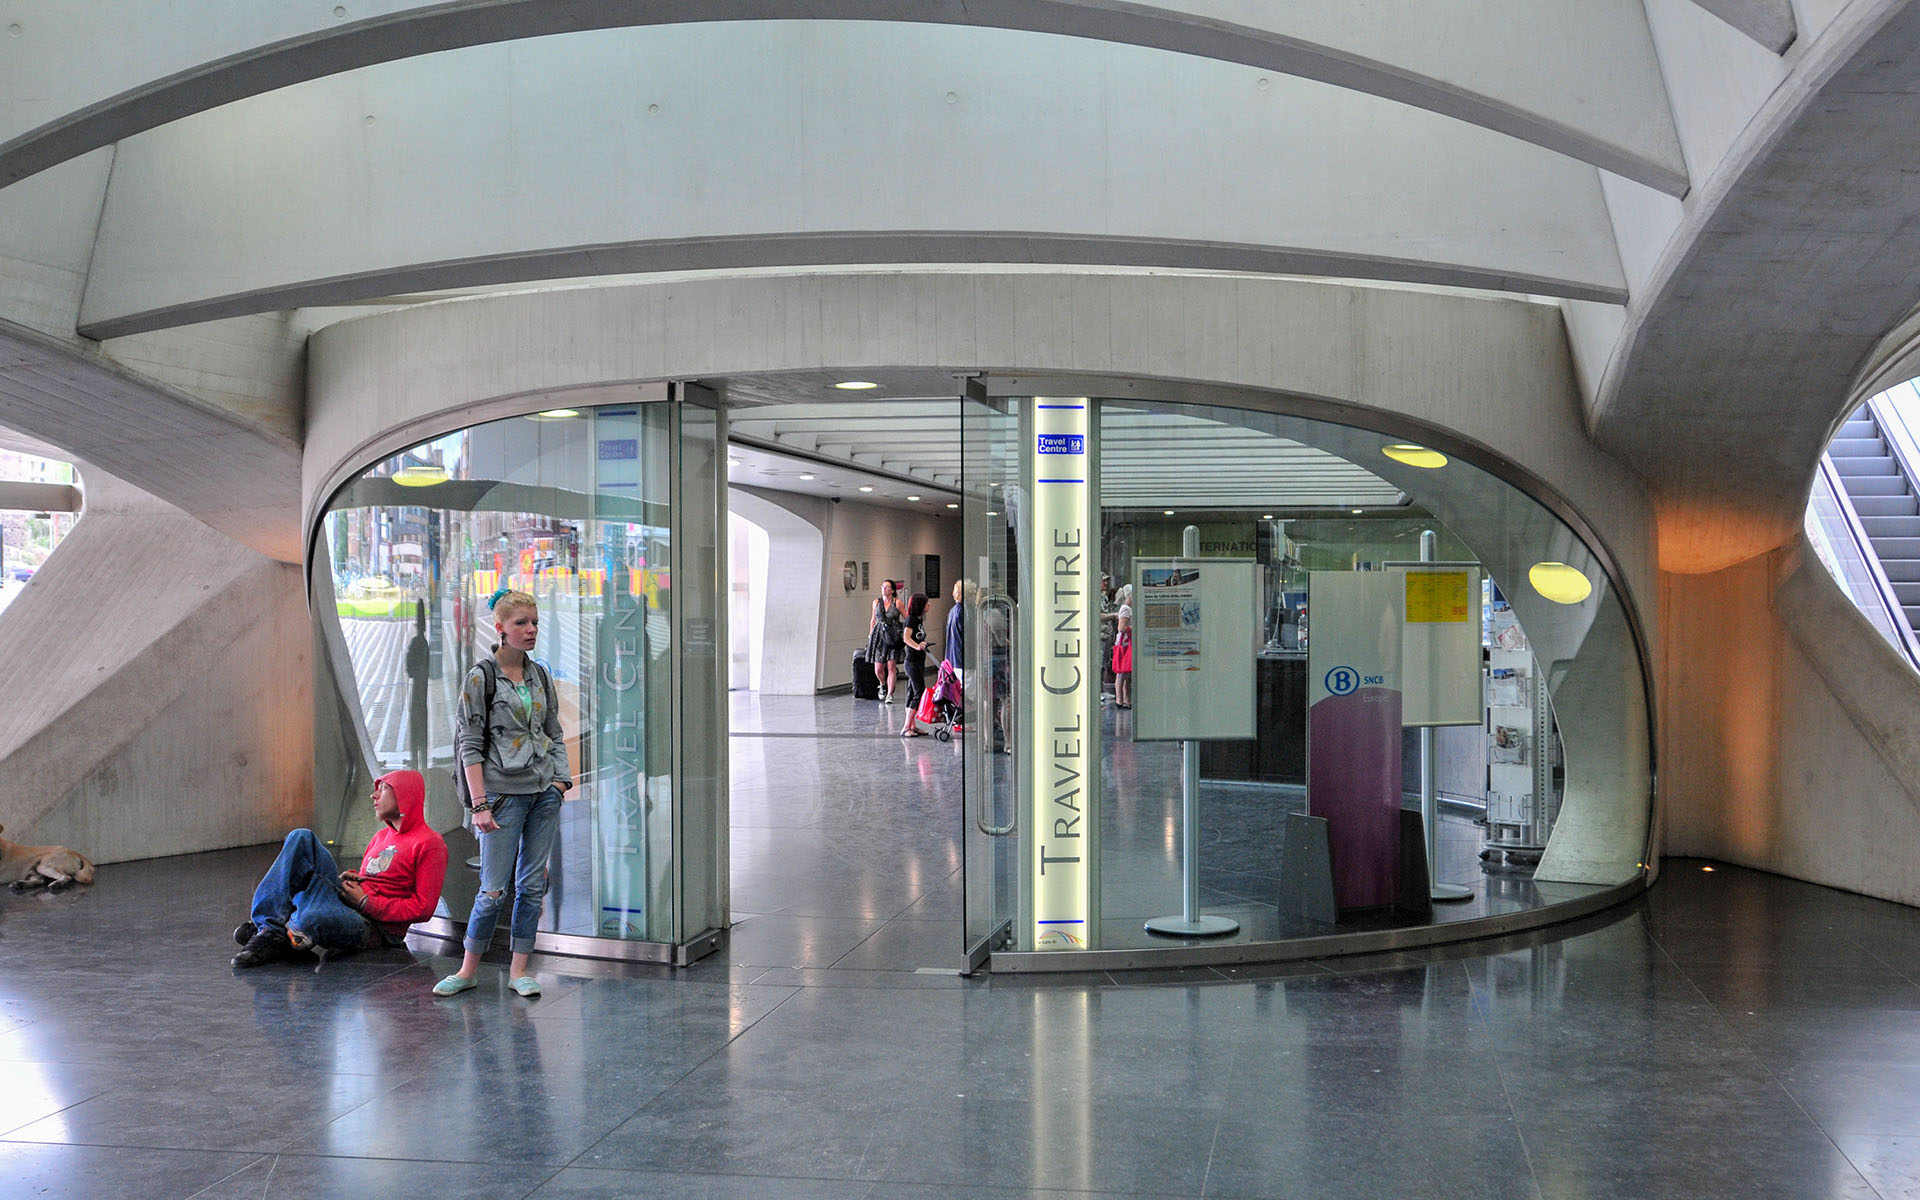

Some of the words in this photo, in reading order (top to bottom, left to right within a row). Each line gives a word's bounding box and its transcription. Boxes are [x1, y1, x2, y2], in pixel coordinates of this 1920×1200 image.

[1039, 437, 1066, 446] Travel
[1039, 445, 1068, 453] Centre
[1041, 528, 1081, 696] CENTRE
[1363, 675, 1385, 685] SNCB
[1041, 714, 1081, 877] TRAVEL
